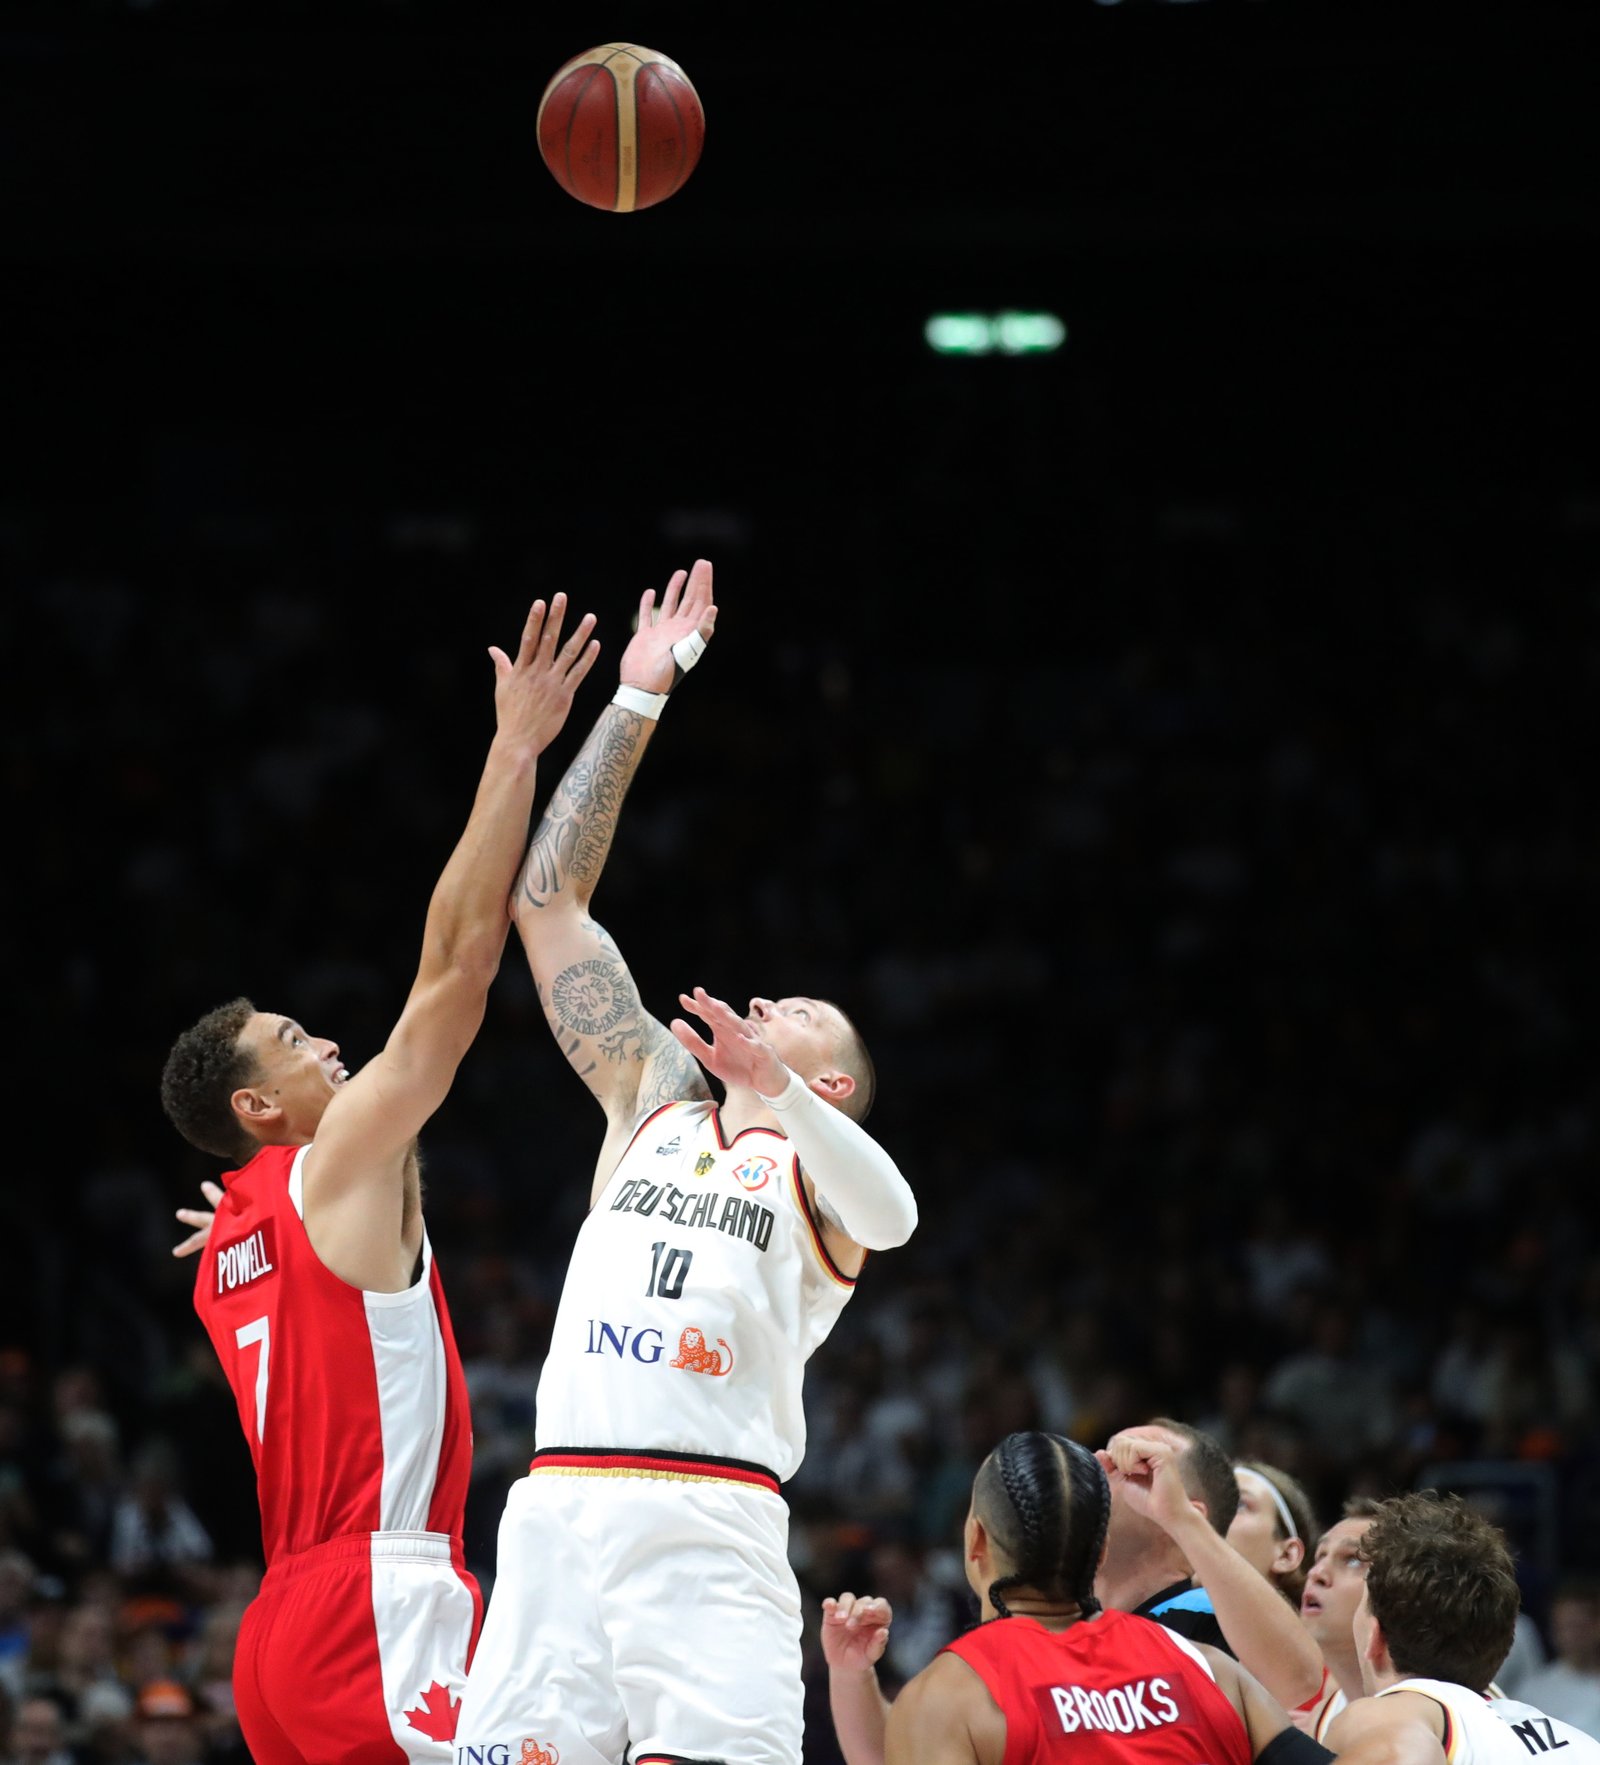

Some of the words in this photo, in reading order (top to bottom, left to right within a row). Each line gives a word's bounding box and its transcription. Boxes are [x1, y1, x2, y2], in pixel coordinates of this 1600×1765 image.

[610, 1178, 775, 1252] DEUSCHLAND
[218, 1230, 272, 1294] POWELL
[645, 1241, 693, 1300] 10
[585, 1319, 665, 1364] ING
[235, 1315, 271, 1446] 7
[1050, 1677, 1179, 1734] BROOKS
[458, 1744, 511, 1765] ING
